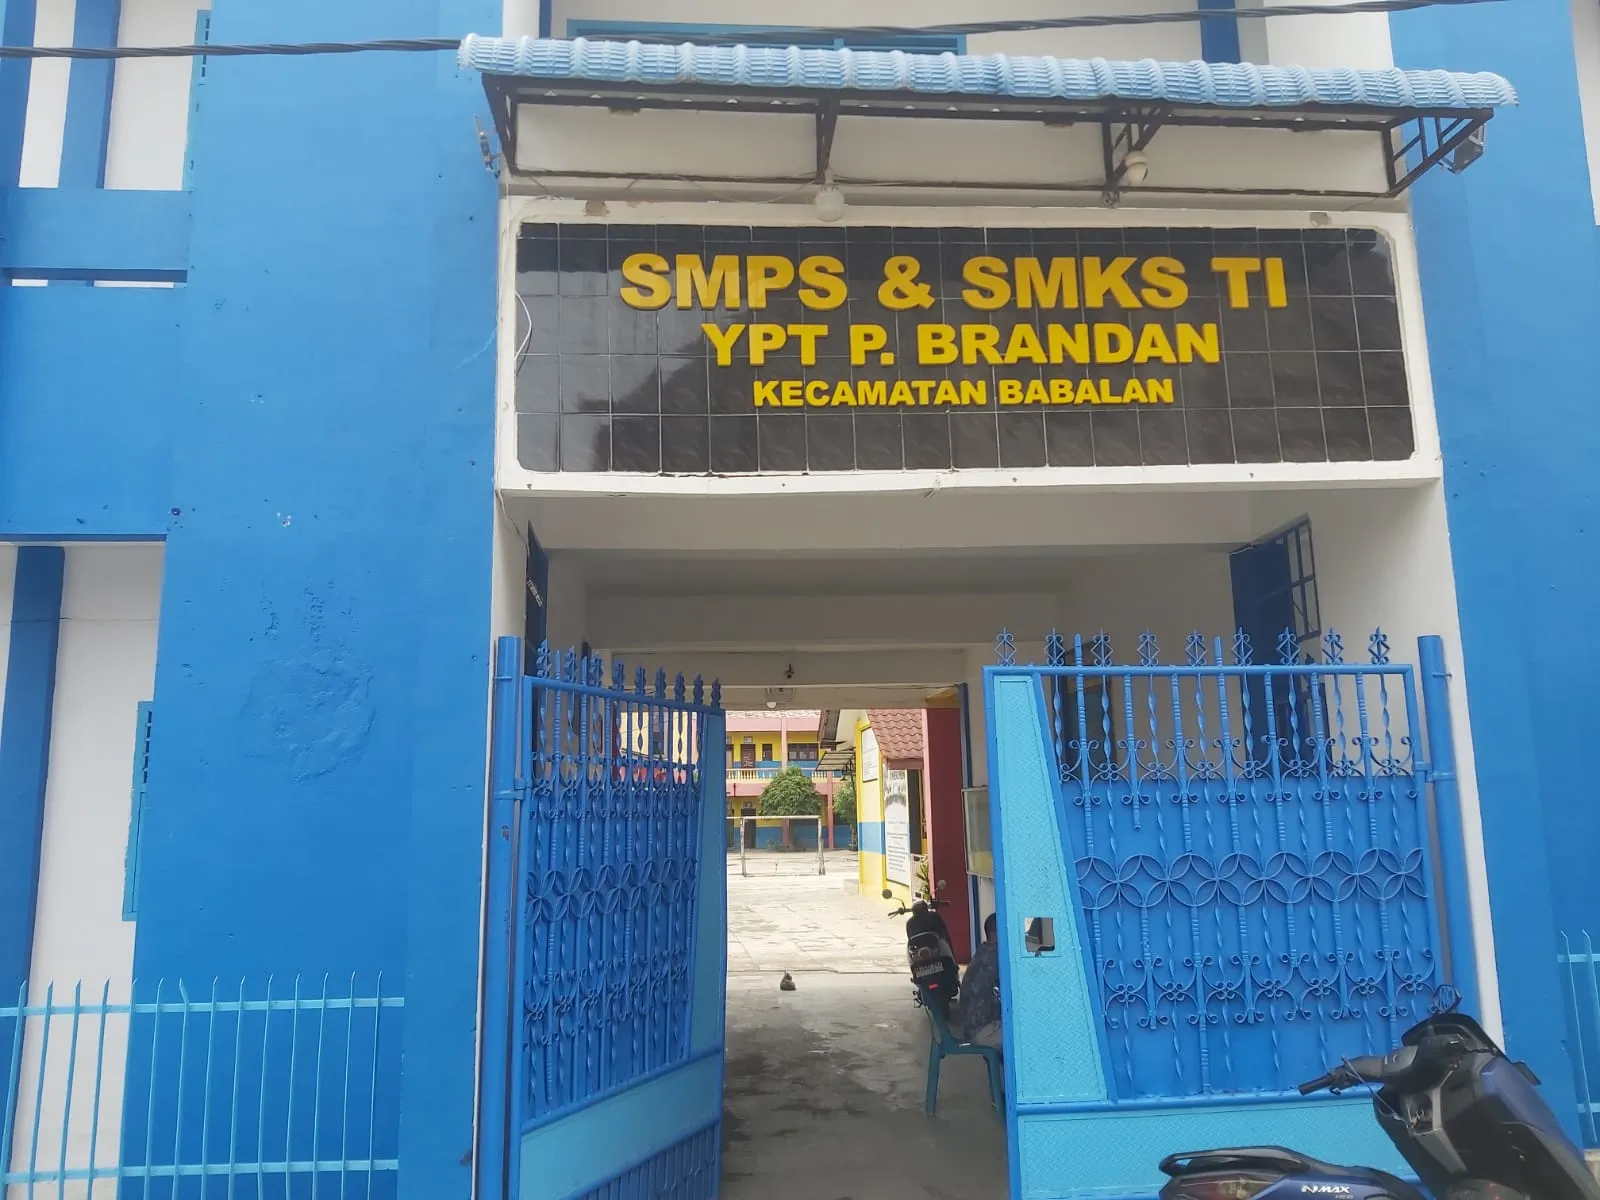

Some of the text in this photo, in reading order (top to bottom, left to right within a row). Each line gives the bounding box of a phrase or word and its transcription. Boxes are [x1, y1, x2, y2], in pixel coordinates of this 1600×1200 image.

[621, 252, 1289, 311] SMPS & SMKS TI
[700, 321, 1222, 368] YPT P. BRANDAN
[752, 377, 1176, 408] KECAMATAN BABALAN
[1301, 1185, 1350, 1193] NMAX
